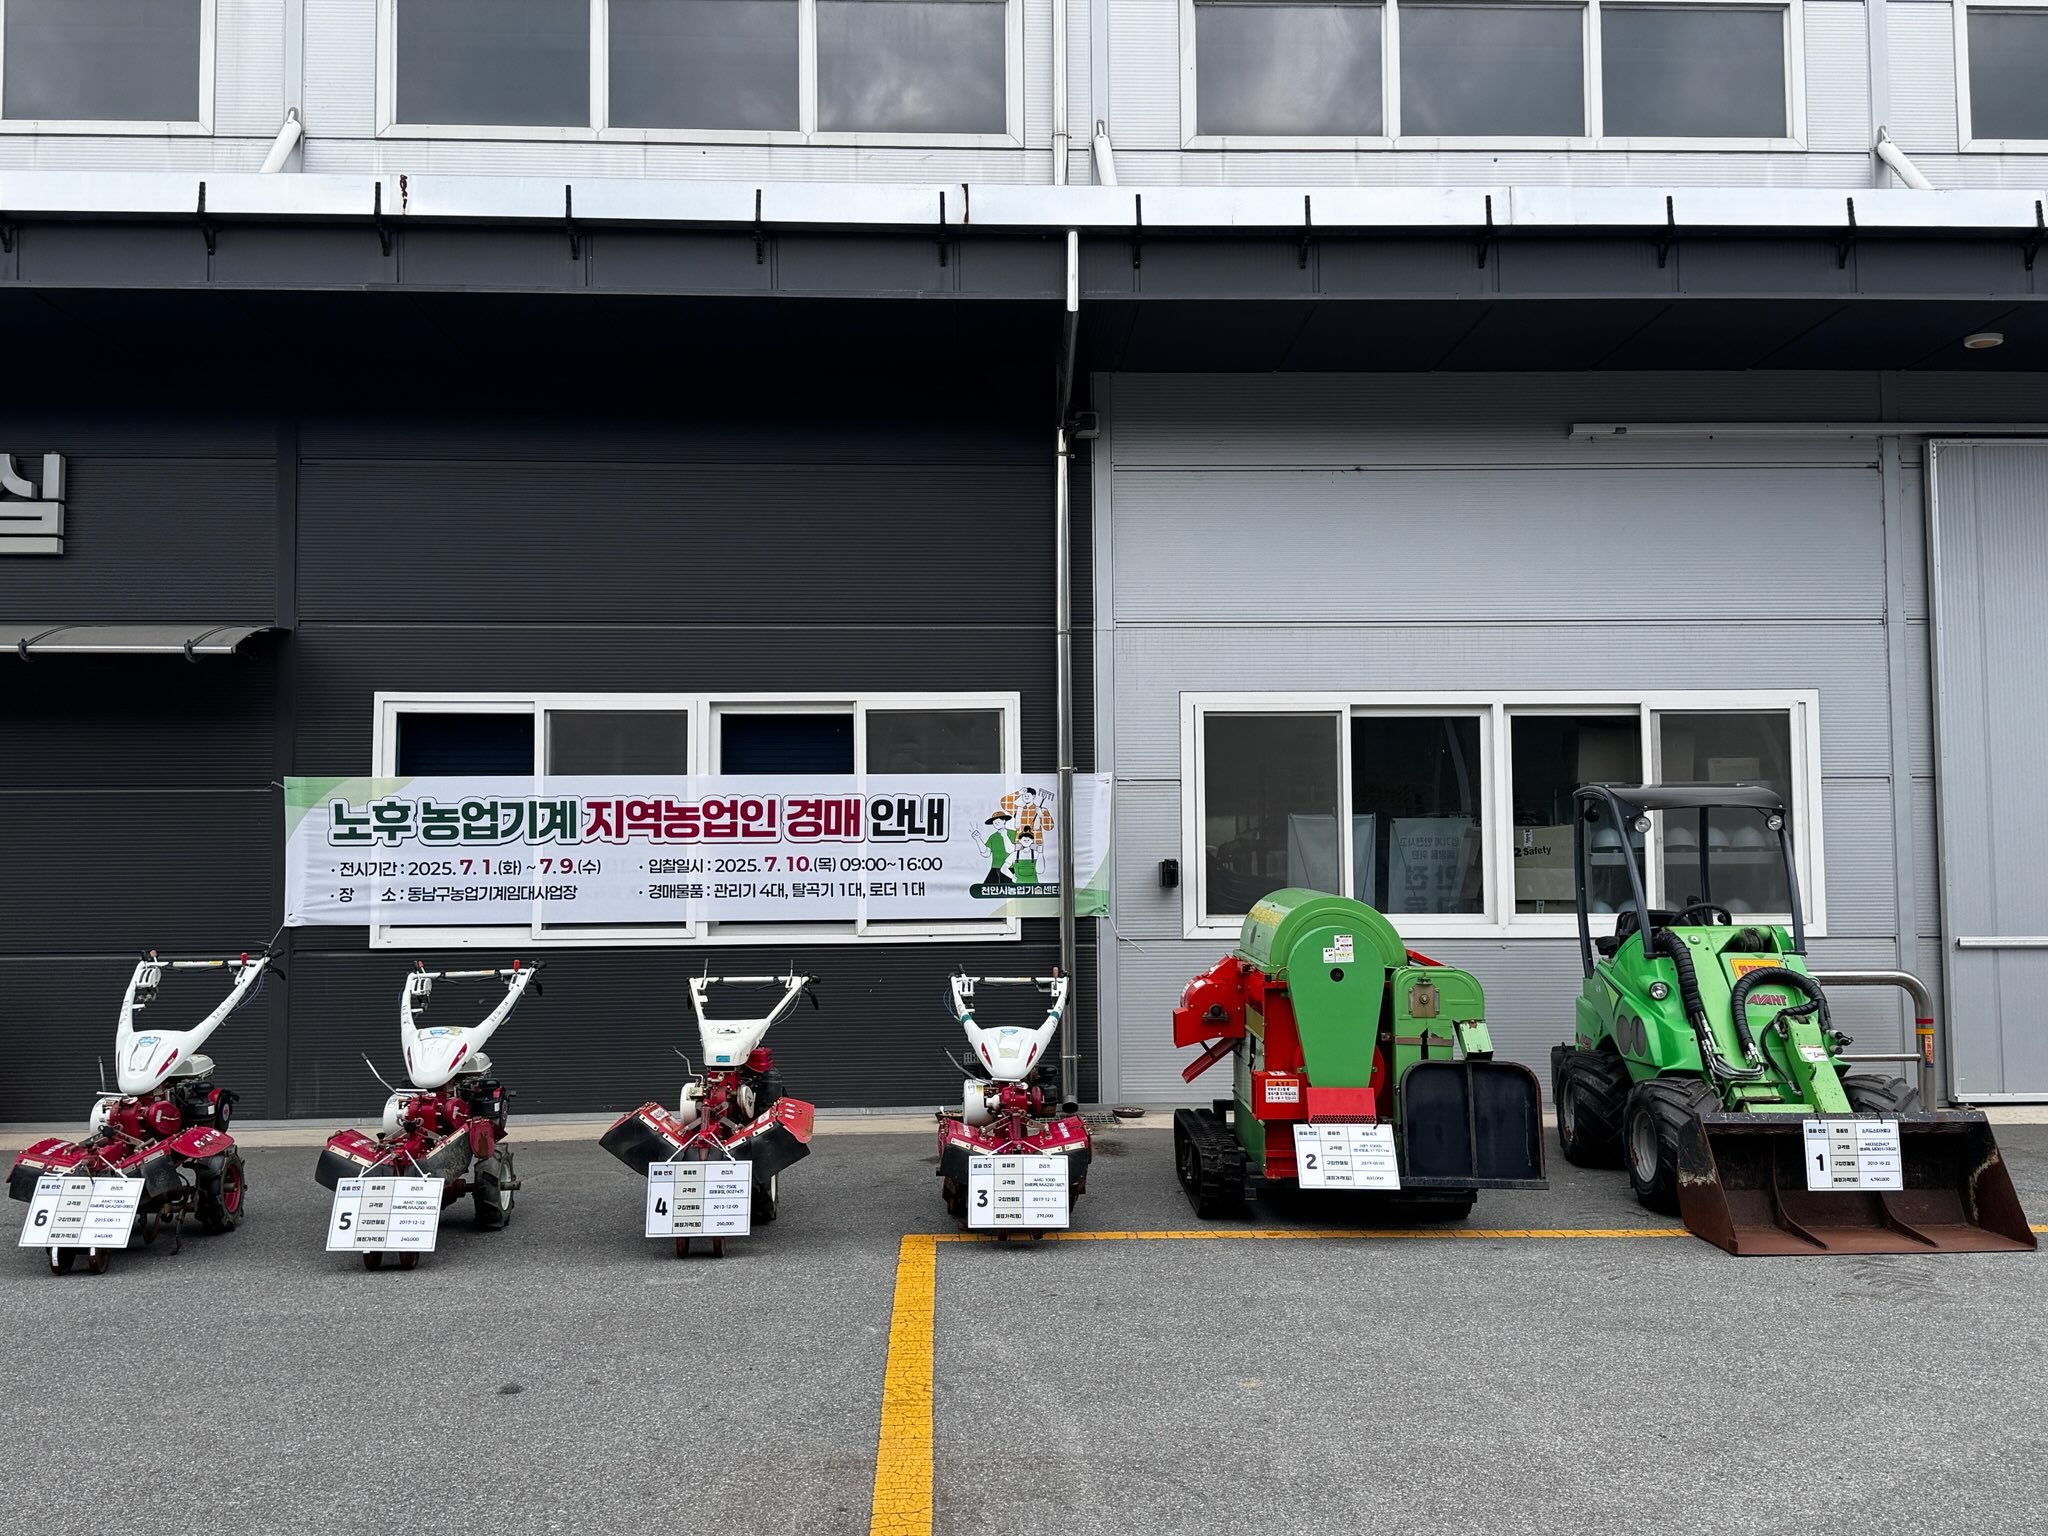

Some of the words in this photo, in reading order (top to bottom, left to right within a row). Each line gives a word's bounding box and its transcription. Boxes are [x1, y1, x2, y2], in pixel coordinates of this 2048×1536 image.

[332, 800, 412, 841] 노후
[421, 799, 577, 841] 농업기계
[585, 799, 777, 840] 지역농업인
[786, 798, 861, 838] 경매
[870, 797, 945, 838] 안내
[1523, 845, 1552, 856] Safety
[339, 861, 398, 877] 전시기간
[407, 861, 457, 876] 2025.
[648, 858, 704, 874] 입찰일시
[714, 858, 761, 873] 2025.
[839, 857, 943, 872] 09:00~16:00
[407, 885, 578, 902] 동남구농업기계임대사업장
[648, 883, 705, 899] 경매물품
[714, 883, 756, 898] 관리기
[759, 882, 788, 900] 4대,
[792, 882, 834, 898] 탈곡기
[839, 882, 866, 899] 1대,
[869, 881, 897, 897] 로더
[902, 881, 926, 896] 1대
[1746, 994, 1787, 1006] AVANT
[1305, 1153, 1318, 1170] 2
[1815, 1153, 1825, 1172] 1
[655, 1197, 668, 1216] 4
[976, 1189, 989, 1208] 3
[34, 1209, 49, 1227] 6
[338, 1212, 353, 1230] 5
